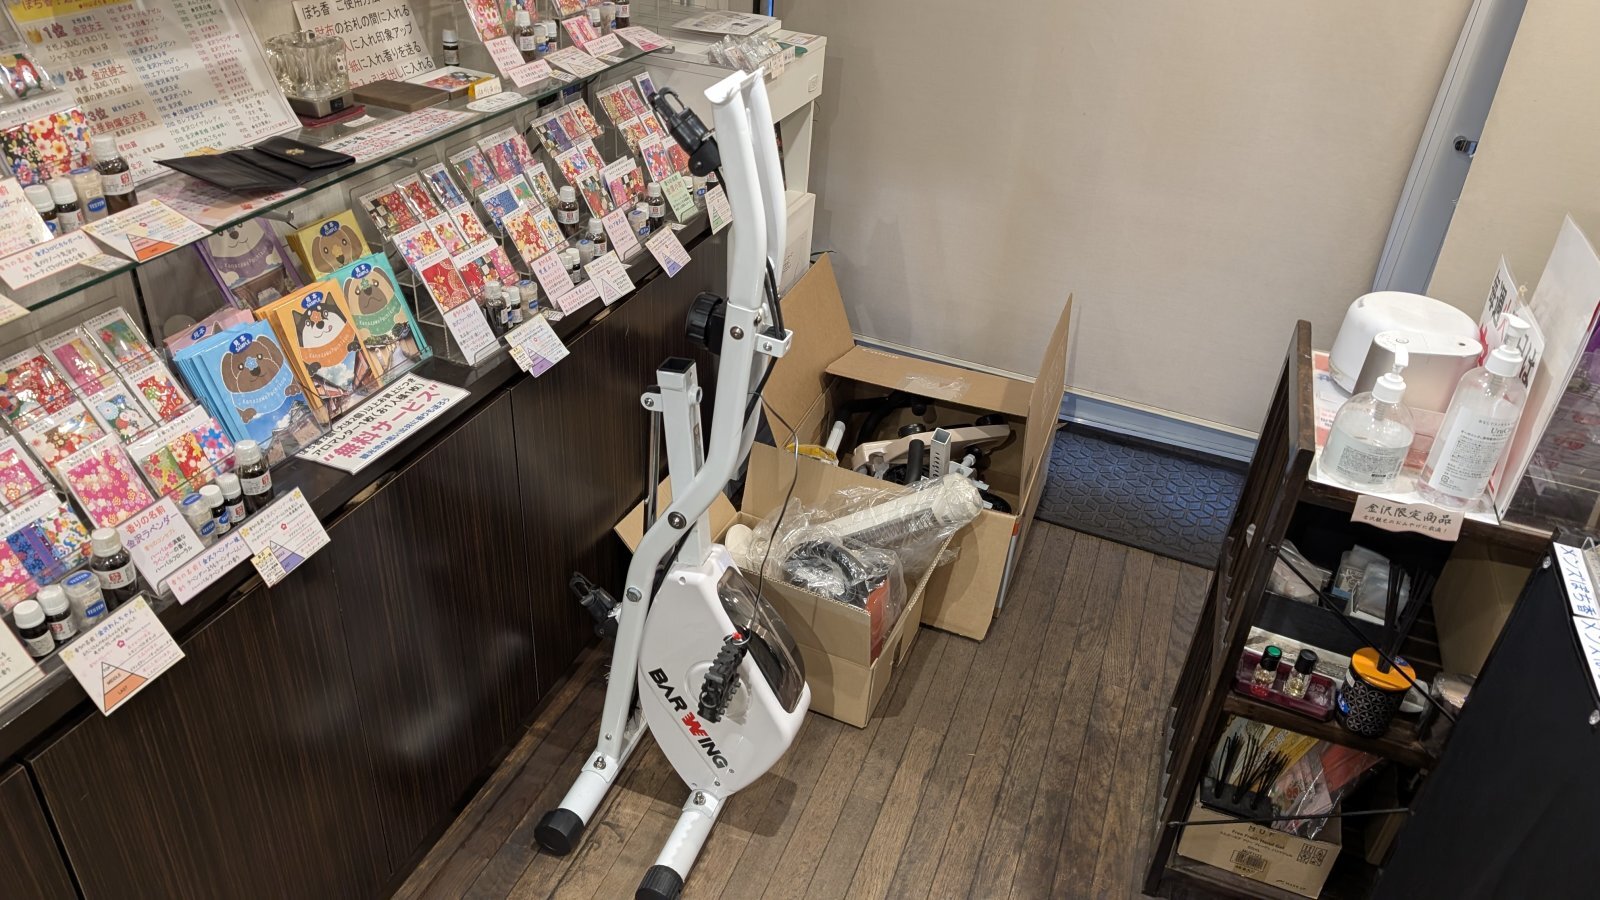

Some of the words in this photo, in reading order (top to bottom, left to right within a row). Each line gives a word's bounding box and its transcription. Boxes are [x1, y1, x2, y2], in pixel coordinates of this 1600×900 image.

[302, 2, 330, 20] ぽち香
[43, 22, 68, 38] 1位
[73, 22, 104, 36] 金沢女王
[66, 66, 88, 82] 2位
[91, 64, 128, 80] 金沢紳士
[88, 107, 109, 122] 3位
[355, 264, 366, 273] 見本
[306, 293, 318, 302] 見本
[233, 336, 246, 347] 見本
[235, 339, 252, 352] SAMPLE
[126, 505, 166, 534] 香りの名前
[1365, 504, 1452, 526] 金沢限定商品
[126, 513, 178, 549] 金沢ラベンダー
[70, 574, 88, 584] TESTER
[88, 604, 104, 614] TESTER
[118, 685, 128, 695] LAST
[1244, 832, 1260, 841] Fresh
